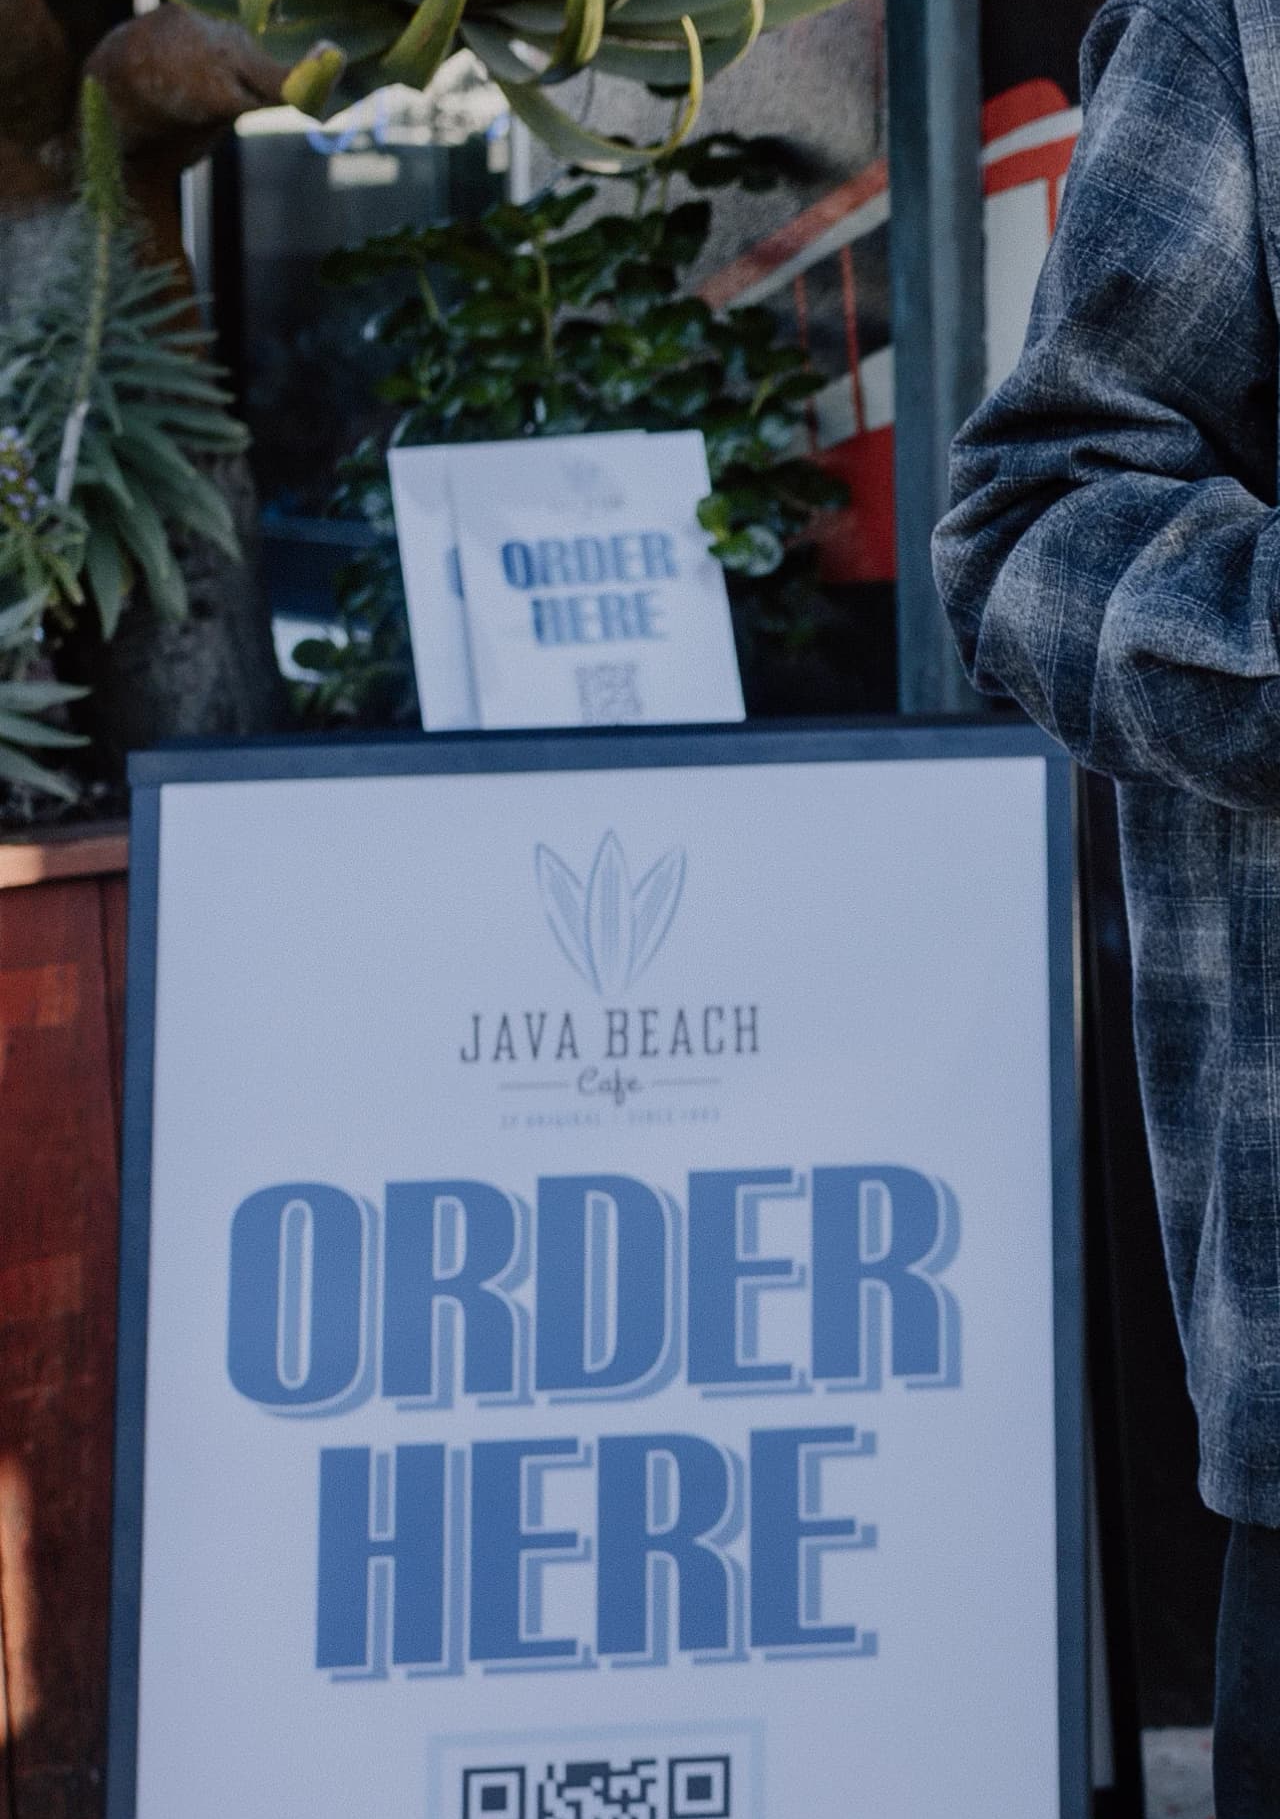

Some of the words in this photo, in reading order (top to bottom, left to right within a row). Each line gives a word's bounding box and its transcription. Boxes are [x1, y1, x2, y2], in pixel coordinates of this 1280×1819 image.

[502, 530, 679, 591] ORDER
[530, 591, 668, 648] HERE
[460, 1011, 580, 1064] JAVA
[605, 1005, 760, 1059] BEACH
[226, 1164, 962, 1419] ORDER
[315, 1425, 878, 1683] HERE
